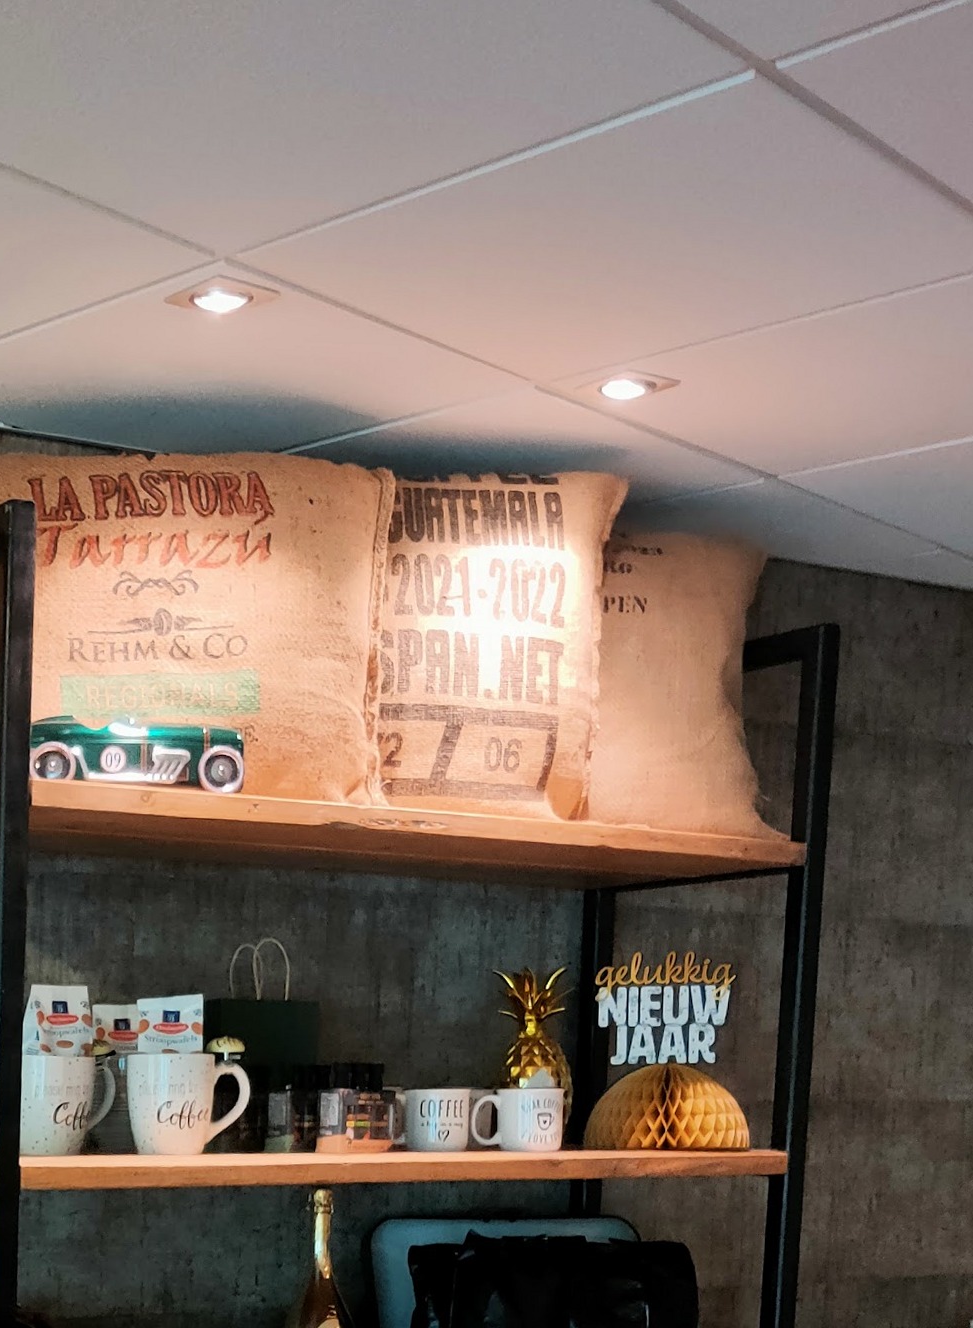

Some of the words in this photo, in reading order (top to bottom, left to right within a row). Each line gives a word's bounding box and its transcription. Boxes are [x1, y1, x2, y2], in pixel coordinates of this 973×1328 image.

[27, 475, 85, 521] LA
[88, 469, 275, 521] PASTORA
[168, 634, 194, 660] &
[105, 752, 122, 769] 09
[484, 737, 523, 773] 06
[595, 951, 737, 1002] gelukkig
[597, 984, 731, 1028] NIEUW
[610, 1022, 716, 1066] JAAR
[419, 1099, 464, 1118] COFFEE
